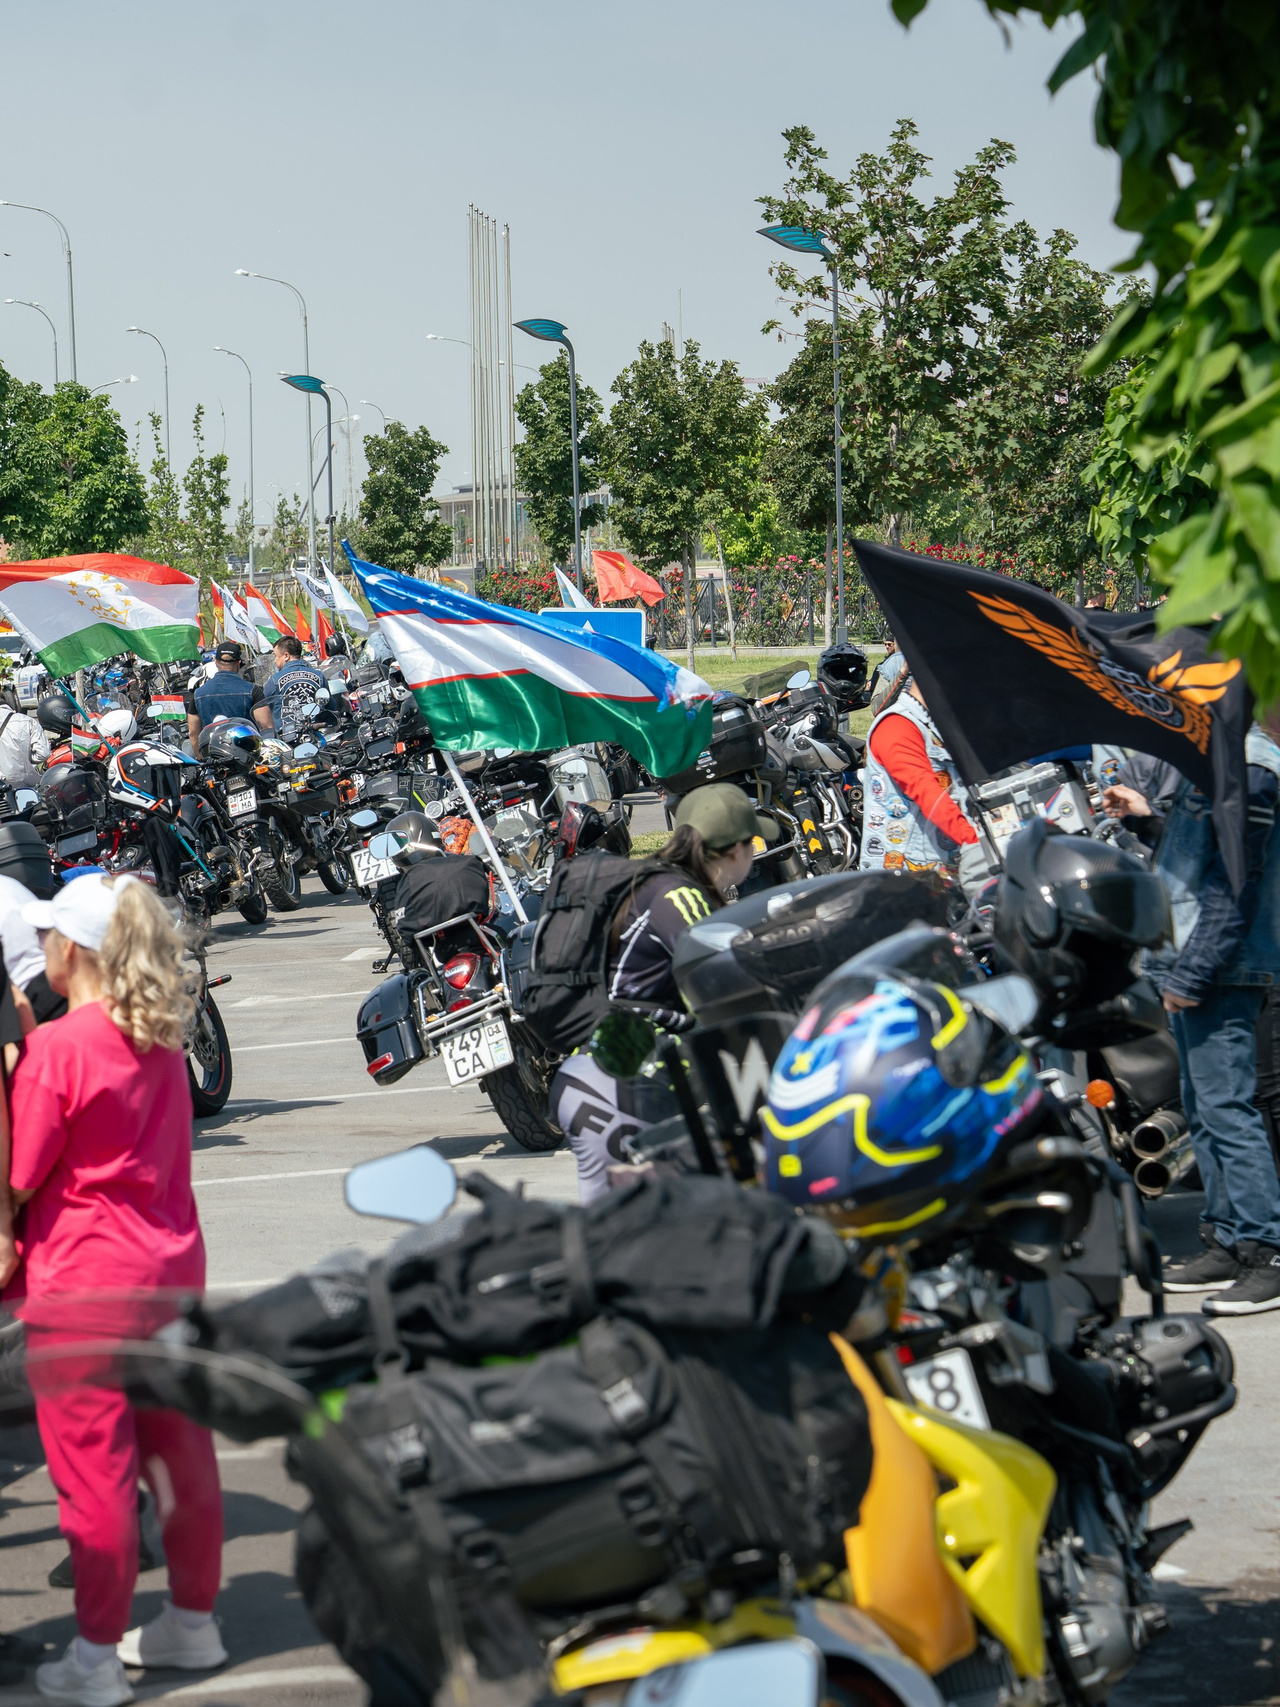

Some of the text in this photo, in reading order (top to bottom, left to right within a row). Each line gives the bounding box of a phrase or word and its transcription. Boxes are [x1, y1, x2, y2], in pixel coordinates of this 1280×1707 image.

[239, 790, 253, 802] 101
[241, 800, 252, 810] MA
[354, 851, 379, 868] 77
[361, 863, 384, 882] ZZ
[443, 1025, 501, 1059] 749 01
[454, 1052, 485, 1078] CA
